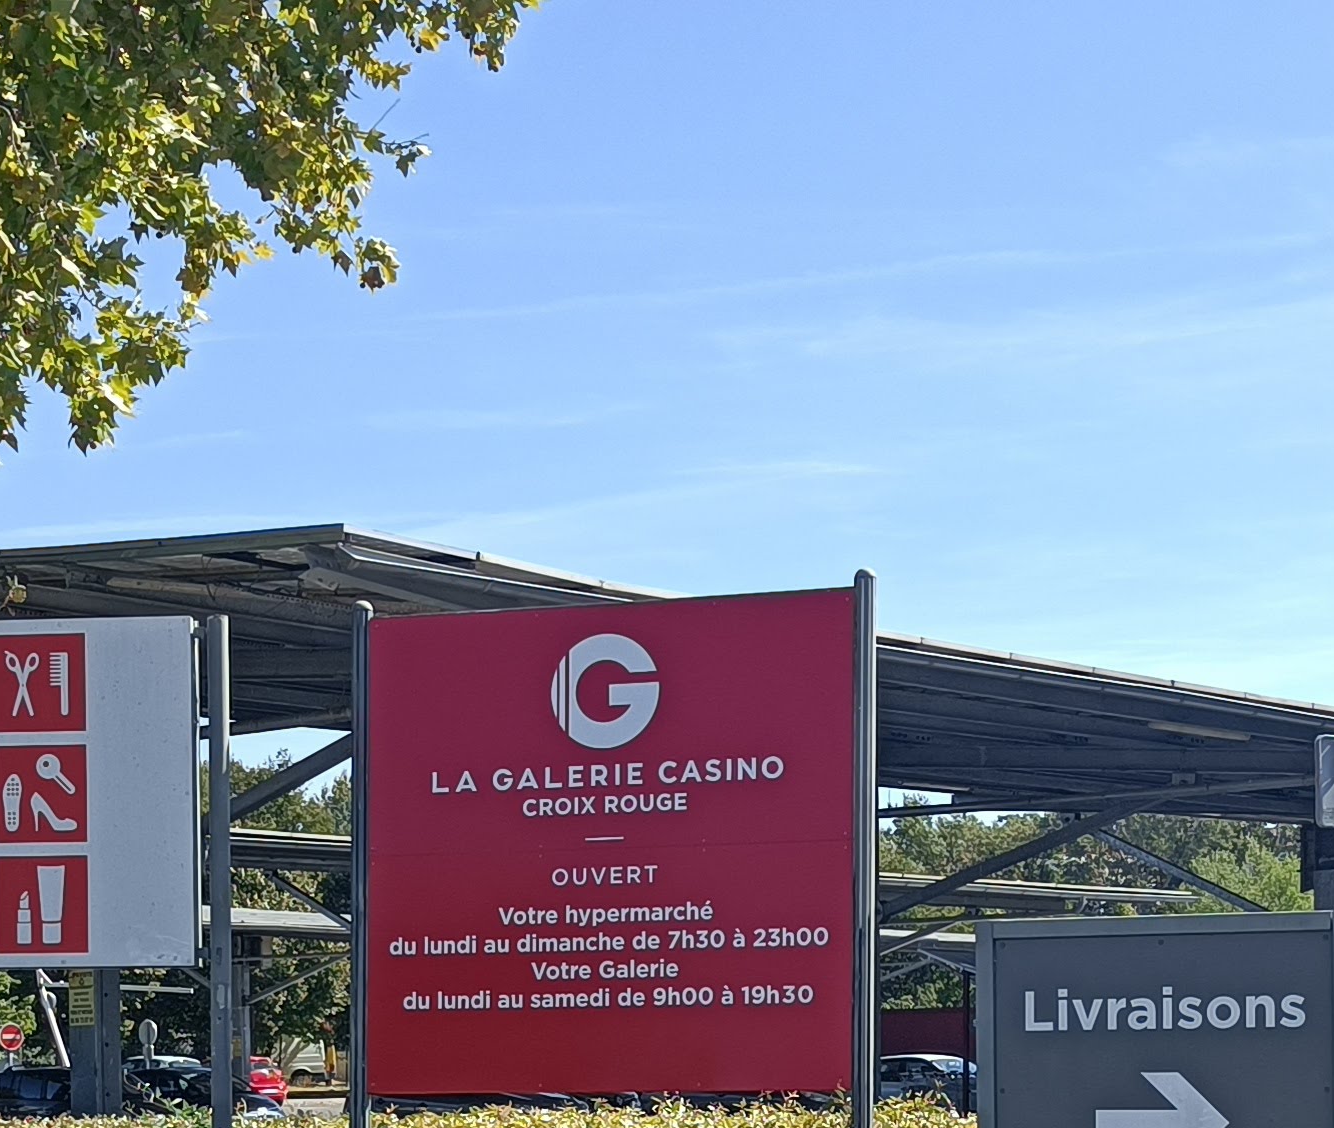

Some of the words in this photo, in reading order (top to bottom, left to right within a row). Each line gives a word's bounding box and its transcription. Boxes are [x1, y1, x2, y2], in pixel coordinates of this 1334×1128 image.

[550, 633, 660, 749] G
[431, 770, 477, 794] LA
[492, 762, 644, 791] GALERIE
[658, 755, 784, 784] CASINO
[522, 796, 596, 817] CROIX
[604, 792, 688, 814] ROUGE
[551, 864, 658, 886] OUVERT
[498, 907, 558, 925] Votre
[565, 900, 714, 927] hypermarché
[389, 936, 417, 956] du
[424, 935, 477, 955] lundi
[483, 938, 510, 954] au
[516, 931, 625, 953] dimanche
[632, 930, 661, 950] de
[668, 929, 726, 949] 7h30
[732, 927, 746, 948] à
[752, 926, 829, 947] 23h00
[530, 961, 592, 980] Votre
[598, 958, 679, 979] Galerie
[403, 991, 430, 1010] du
[437, 990, 491, 1010] lundi
[497, 994, 523, 1009] au
[530, 987, 610, 1009] samedi
[617, 987, 646, 1007] de
[653, 986, 714, 1006] 9h00
[721, 984, 734, 1005] à
[741, 984, 814, 1005] 19h30
[1024, 986, 1306, 1032] Livraisons
